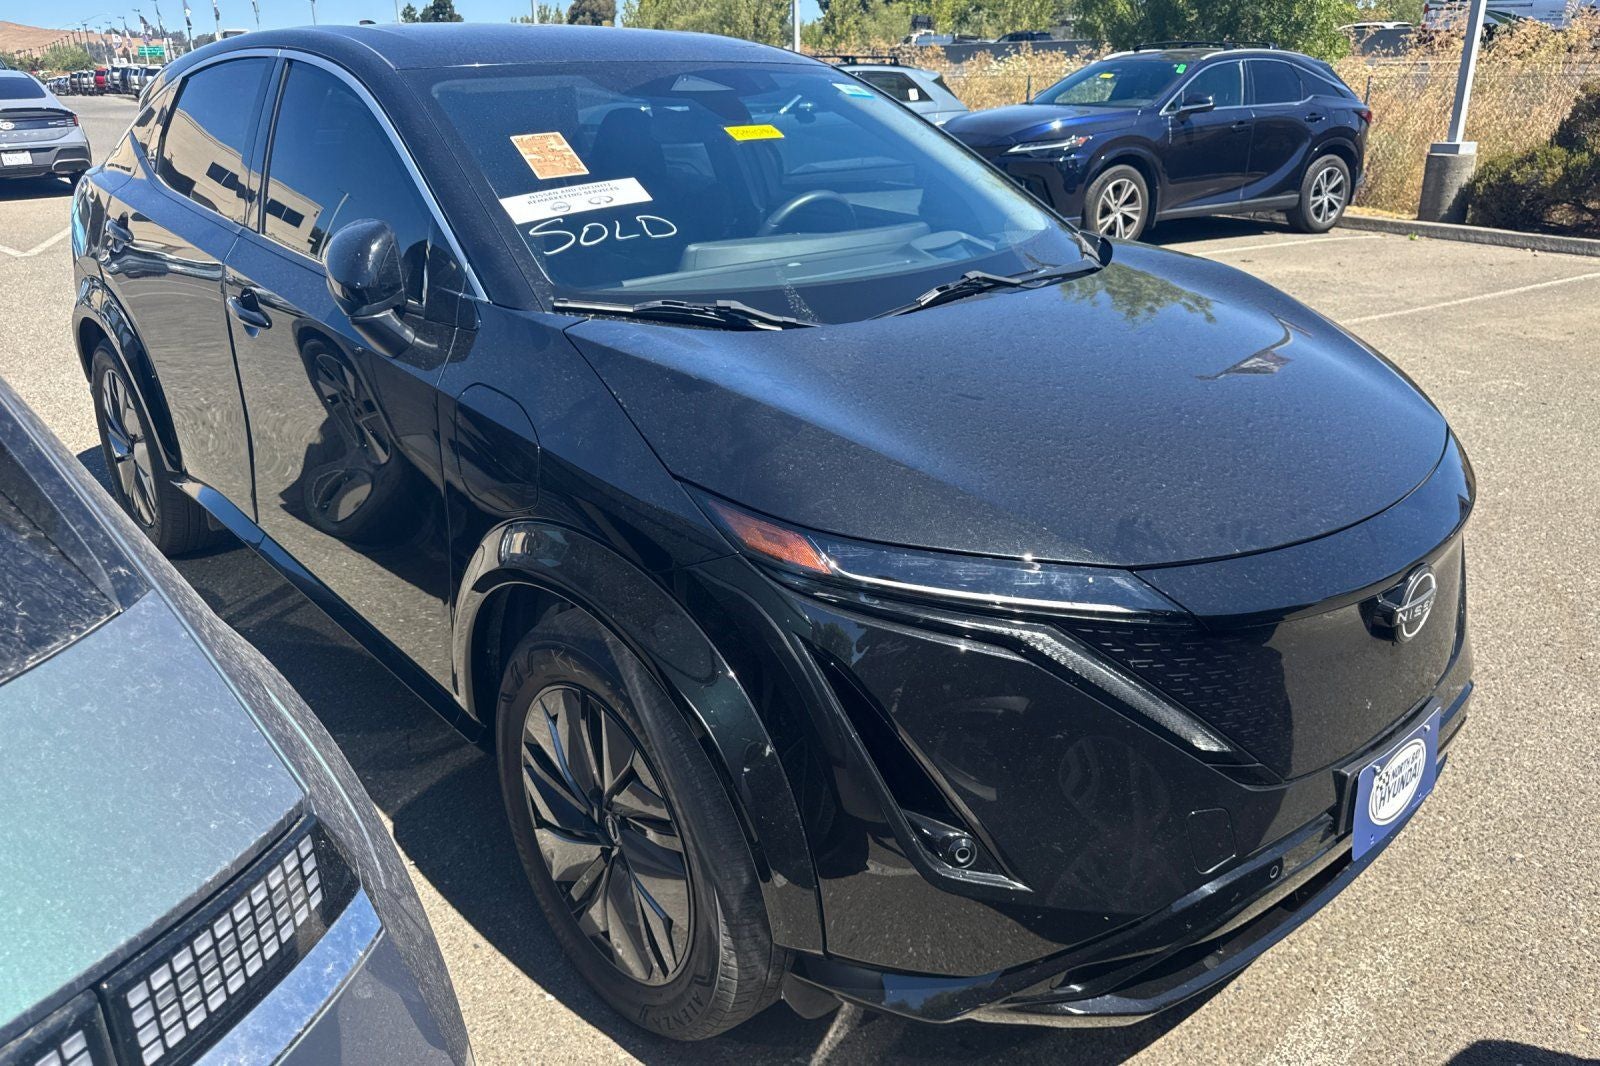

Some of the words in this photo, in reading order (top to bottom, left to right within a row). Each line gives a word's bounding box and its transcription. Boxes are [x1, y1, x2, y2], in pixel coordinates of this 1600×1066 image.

[527, 193, 583, 205] REMARKETING
[584, 186, 620, 196] SERVICES
[529, 191, 559, 200] NISSAN
[578, 183, 612, 191] INFINITI
[528, 214, 678, 256] SOLD
[1391, 757, 1410, 779] NORTH
[1378, 757, 1422, 811] HYUNDAI
[650, 990, 705, 1030] ALENZA
